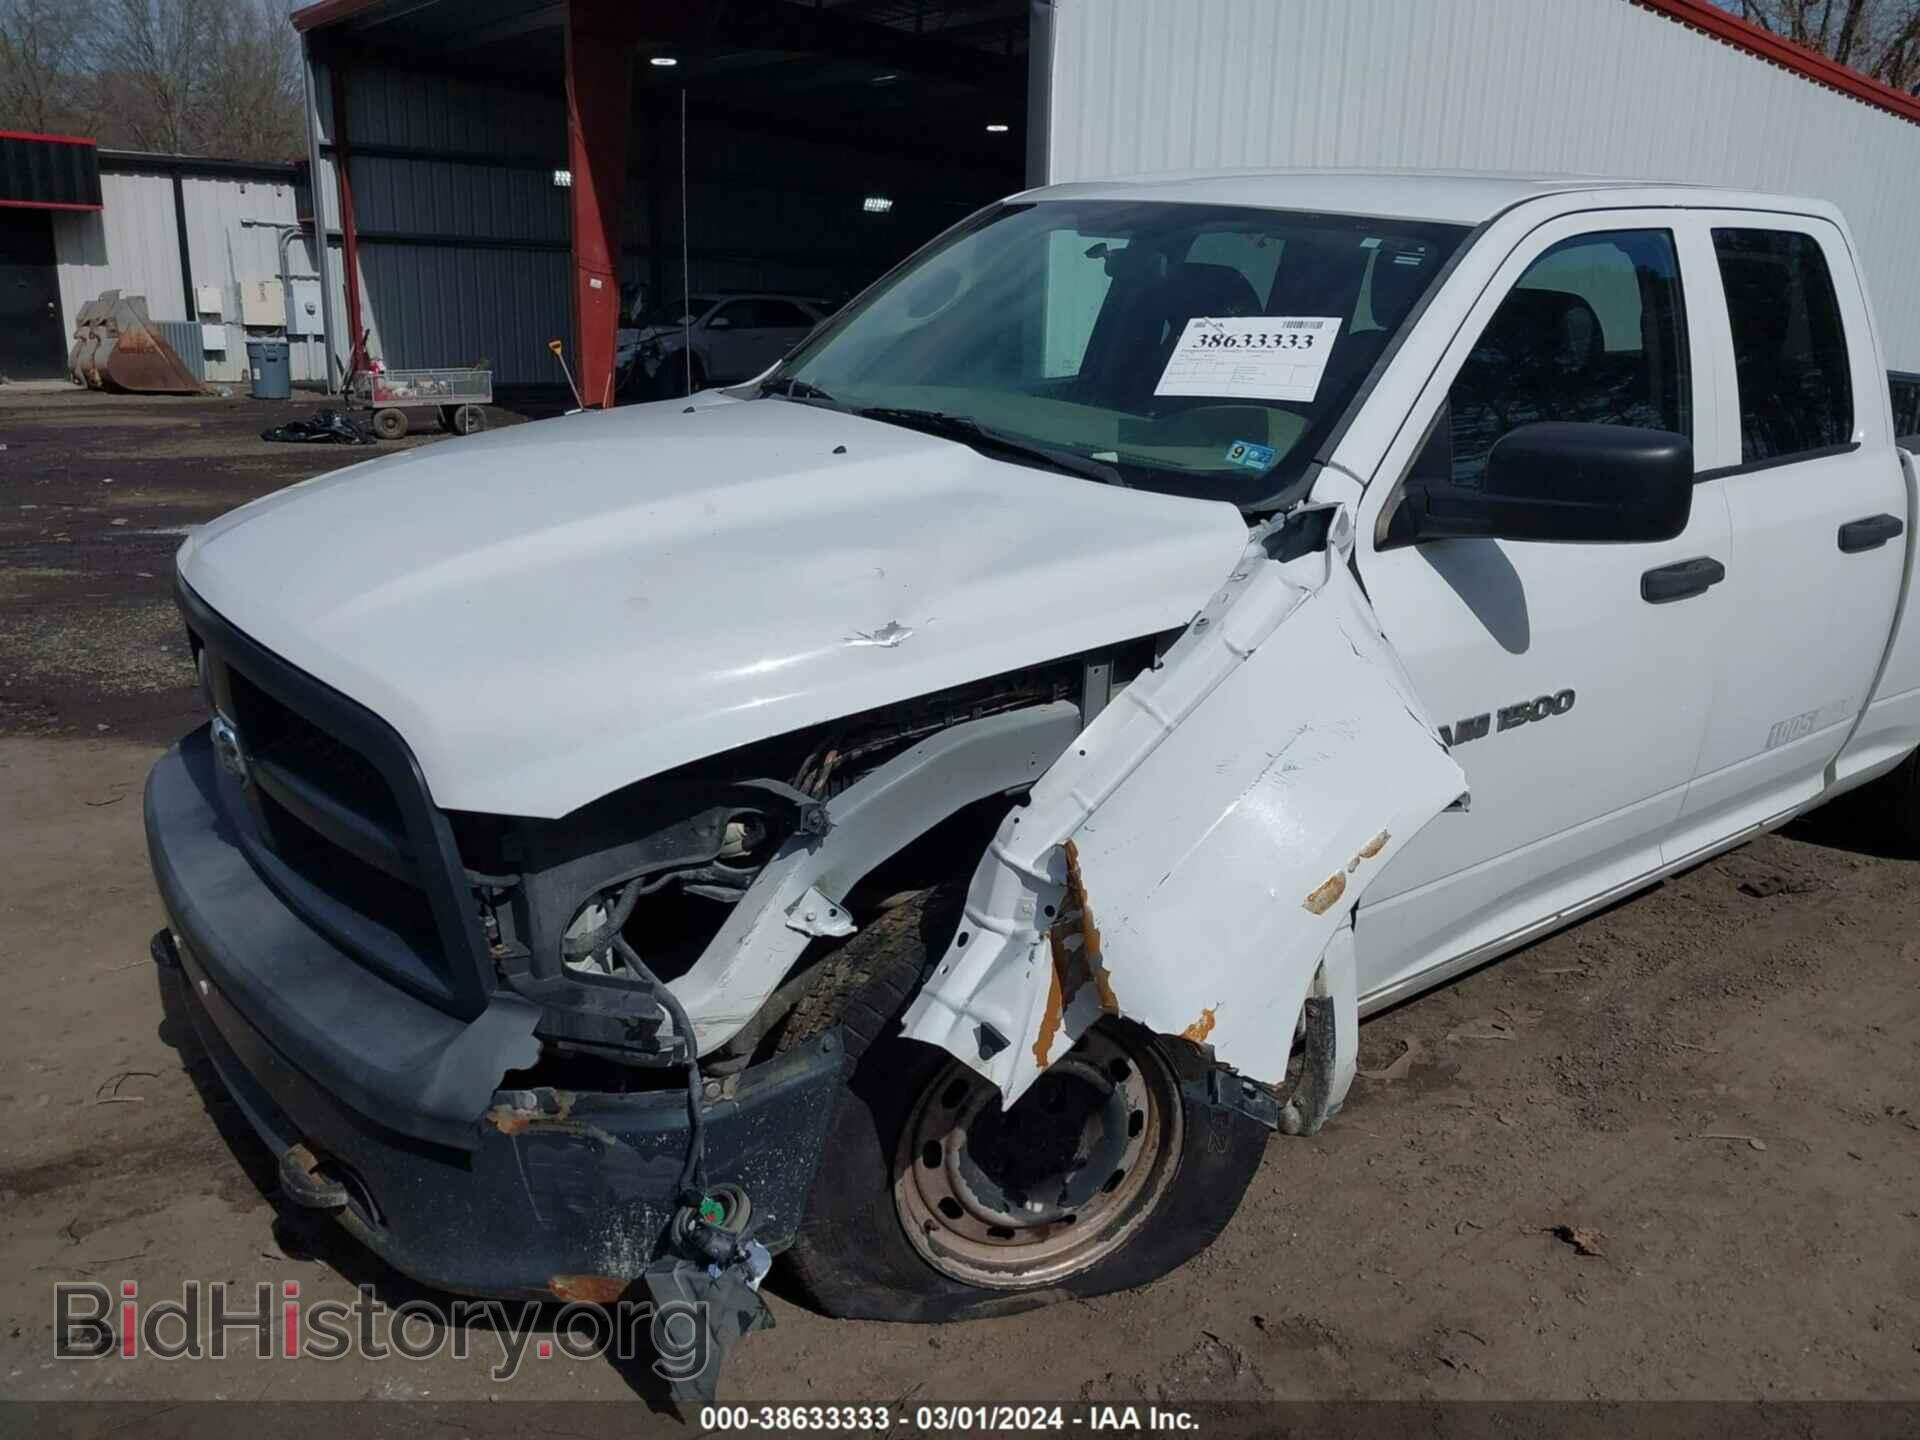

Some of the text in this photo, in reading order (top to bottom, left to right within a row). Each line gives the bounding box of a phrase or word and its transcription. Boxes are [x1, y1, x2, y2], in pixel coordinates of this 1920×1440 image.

[1192, 333, 1315, 350] 38633333
[1231, 446, 1245, 460] 9
[1497, 688, 1576, 733] 1500
